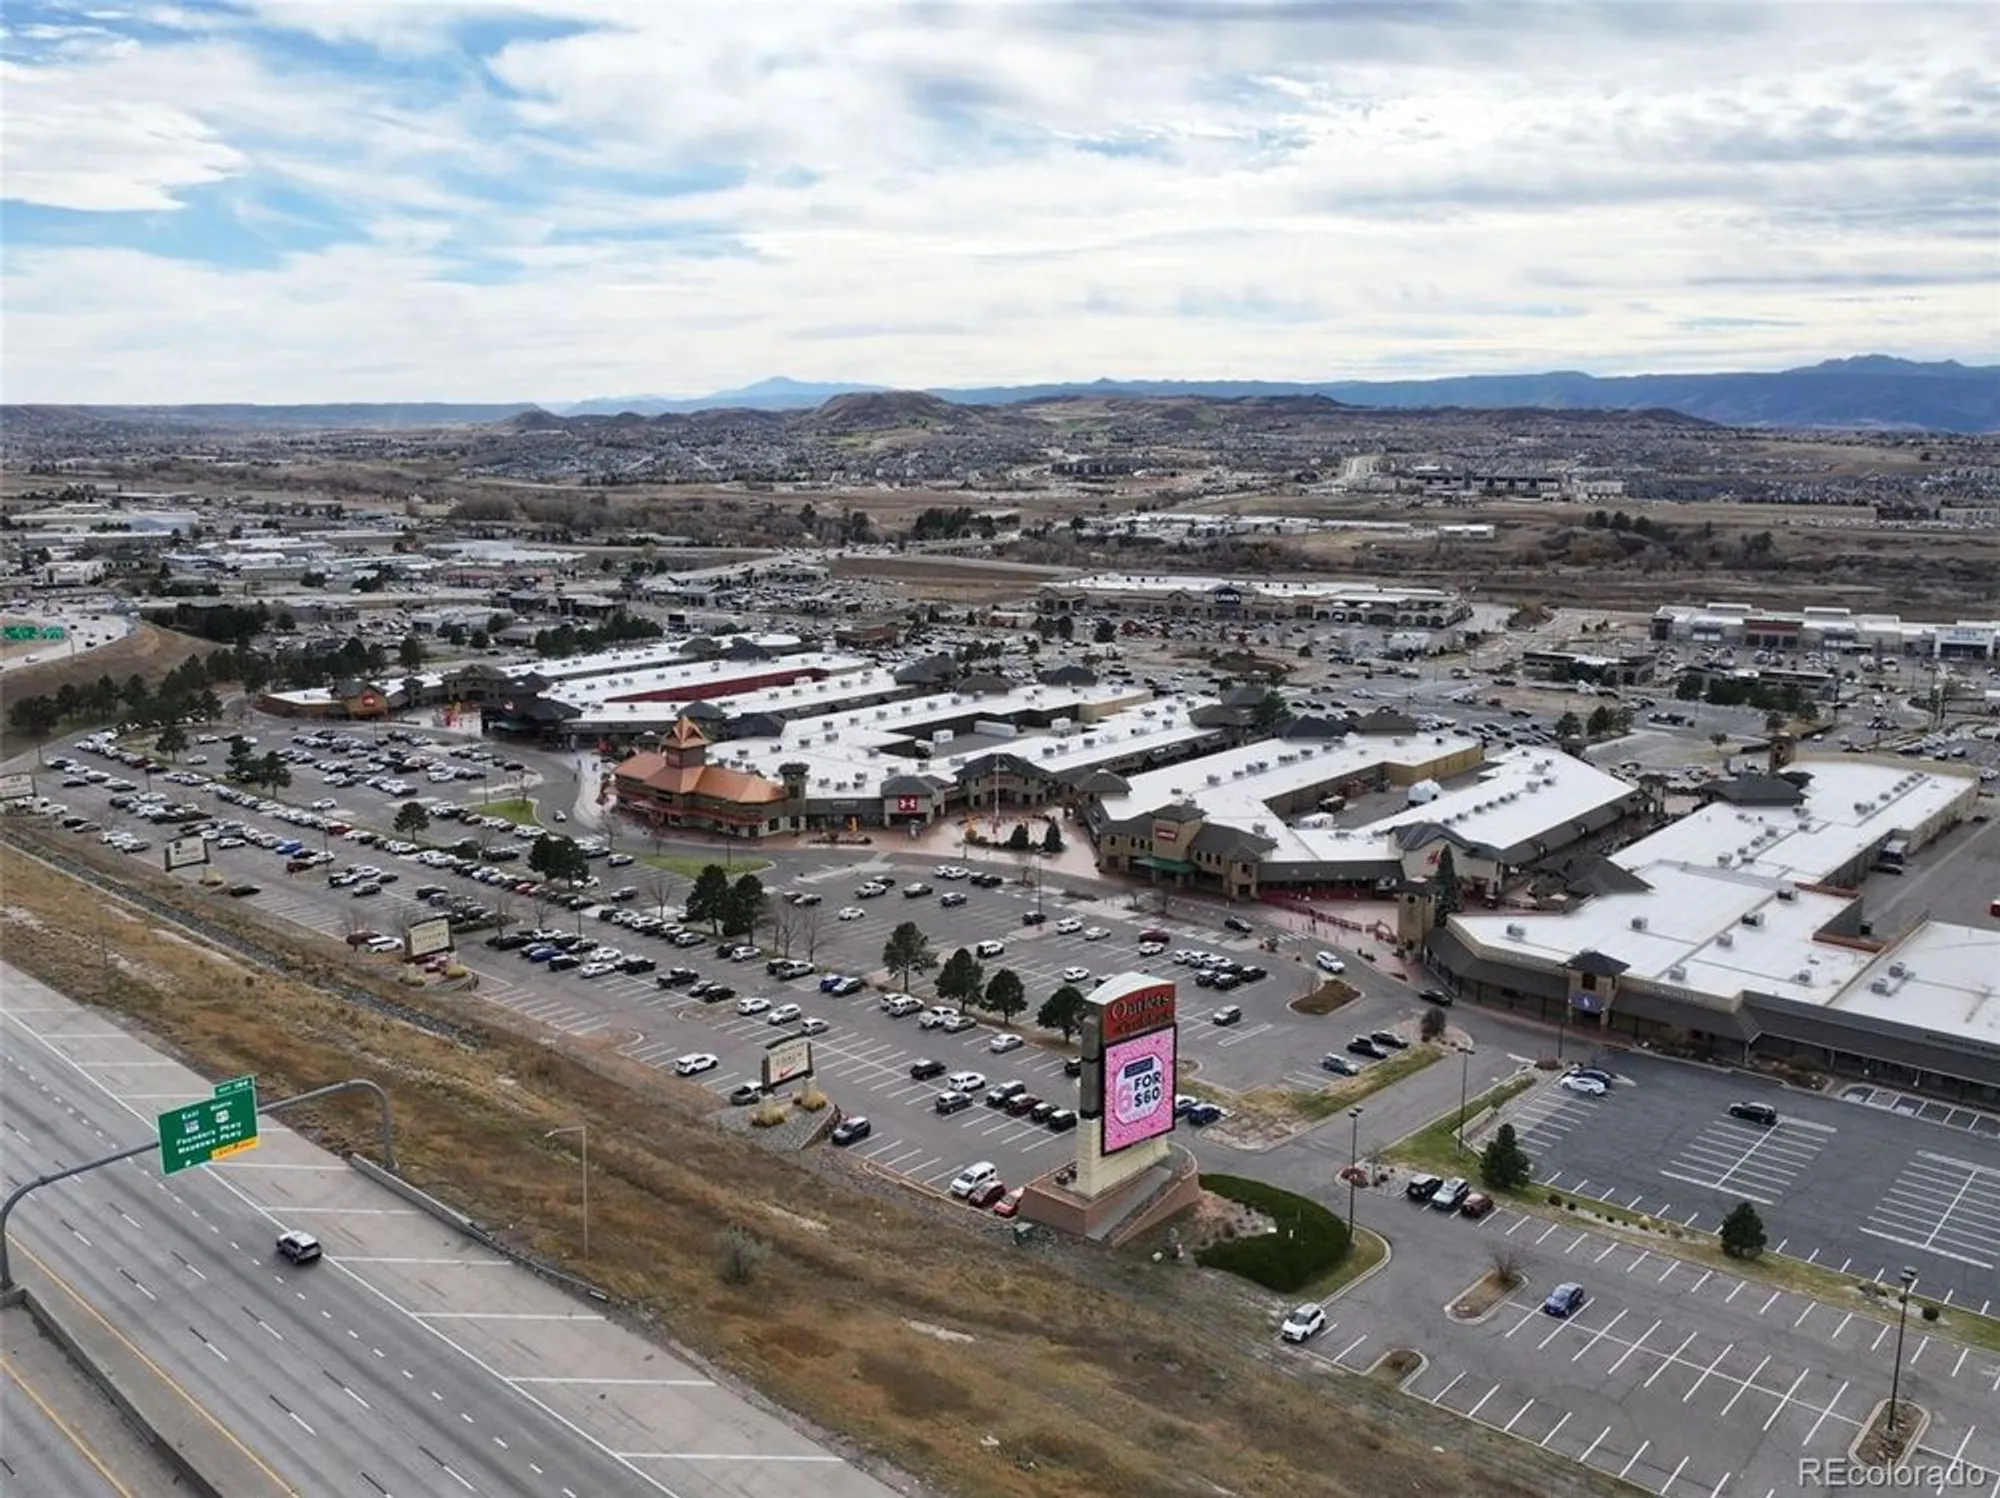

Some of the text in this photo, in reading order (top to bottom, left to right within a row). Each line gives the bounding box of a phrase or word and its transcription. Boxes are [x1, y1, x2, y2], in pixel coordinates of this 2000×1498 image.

[1112, 993, 1169, 1021] Outlets
[1134, 1071, 1161, 1091] FOR
[1134, 1087, 1161, 1107] $60
